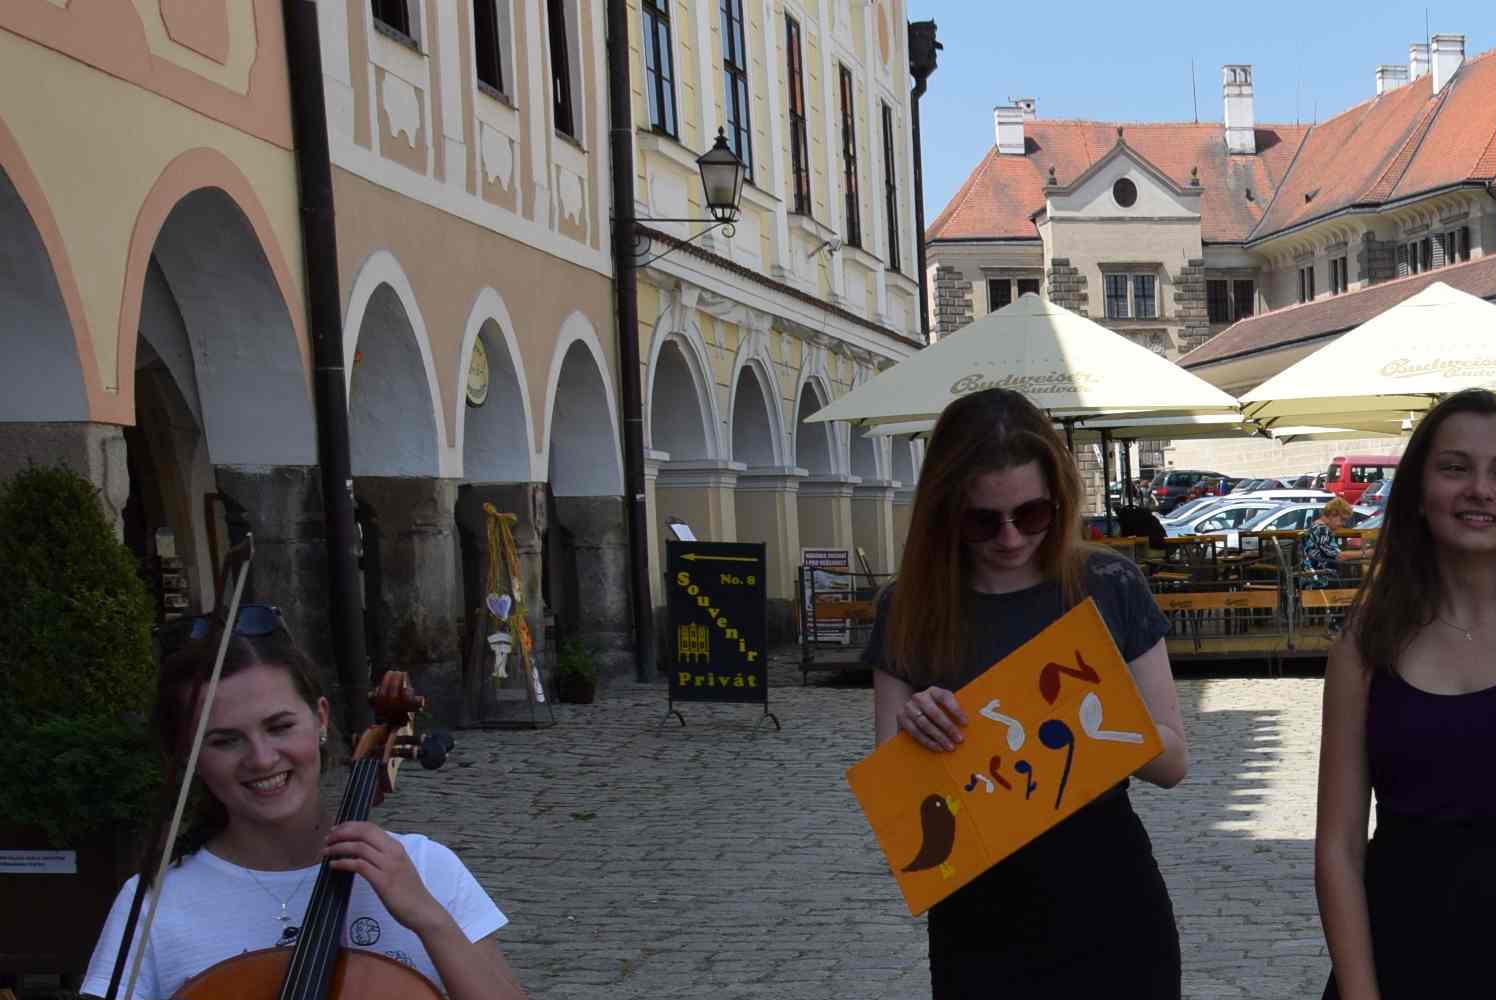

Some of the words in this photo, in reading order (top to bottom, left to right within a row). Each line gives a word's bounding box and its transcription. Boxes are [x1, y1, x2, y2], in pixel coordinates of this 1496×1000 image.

[719, 573, 743, 585] No.
[747, 575, 756, 585] 8
[676, 571, 758, 662] Souvenir
[677, 671, 758, 687] Privát
